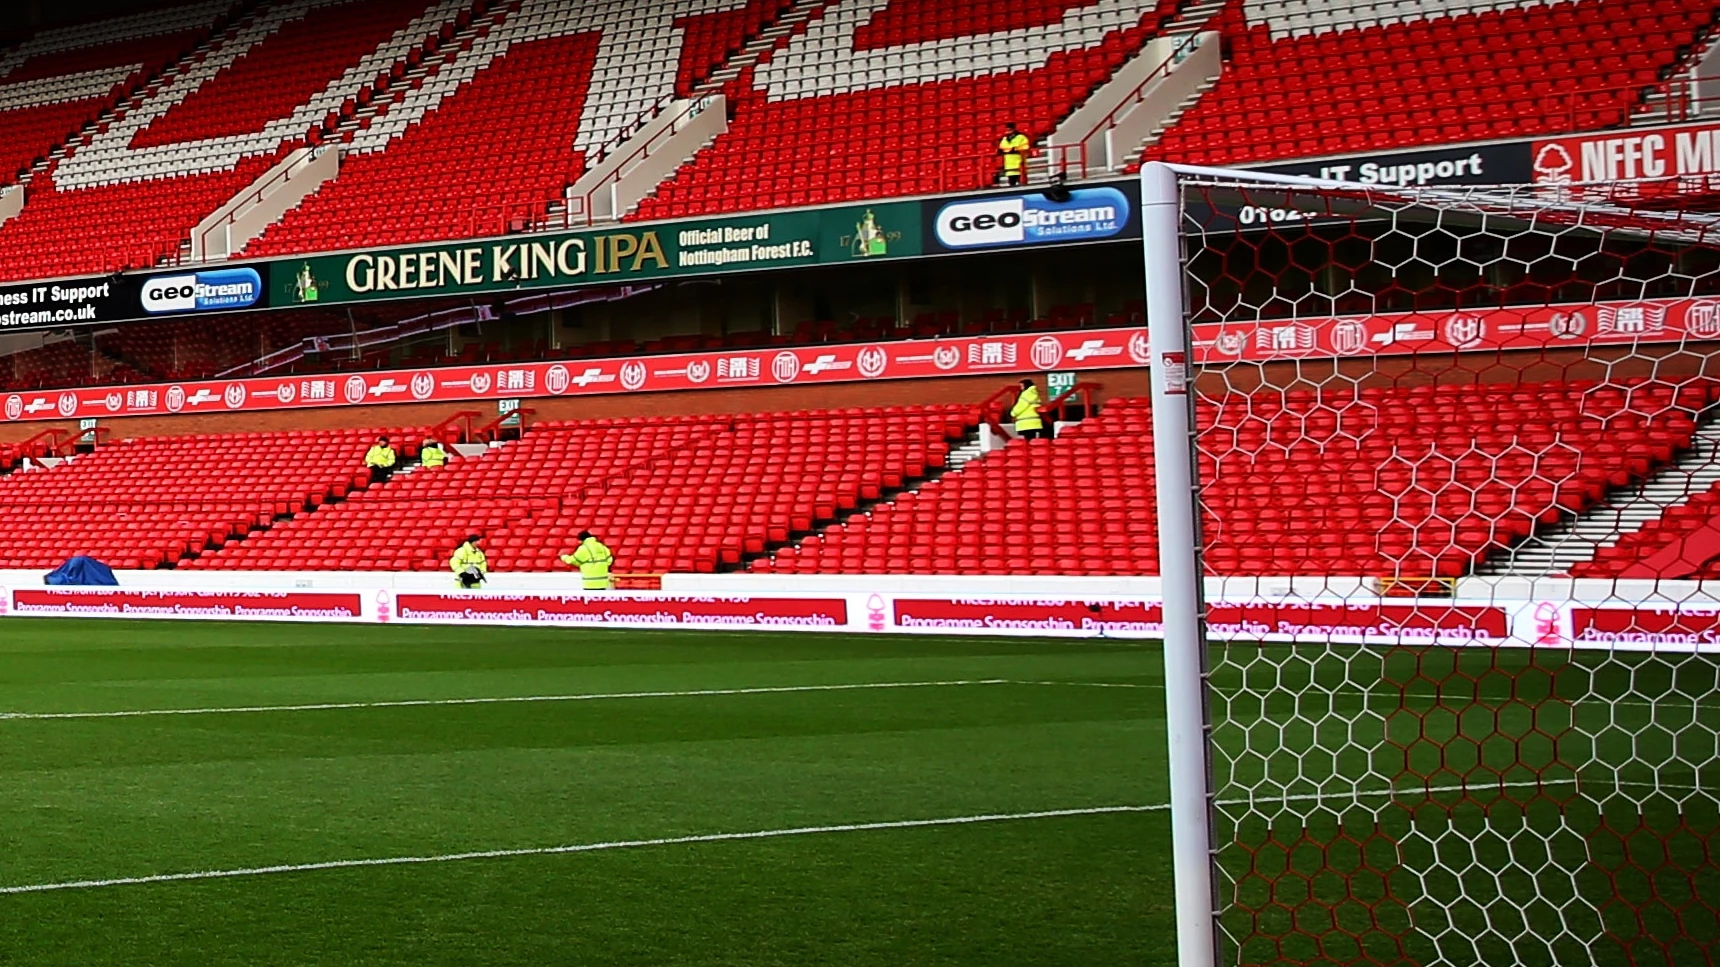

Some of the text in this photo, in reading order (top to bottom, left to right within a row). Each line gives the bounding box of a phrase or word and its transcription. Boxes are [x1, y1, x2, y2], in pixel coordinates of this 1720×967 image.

[1359, 153, 1483, 186] Support
[1581, 134, 1665, 182] NFFC
[679, 223, 769, 246] Official Beer of
[1037, 221, 1118, 236] Solutions Ltd.
[346, 231, 669, 293] GREENE KING IPA
[679, 240, 814, 266] Nottingham Forest F.C.
[32, 287, 46, 303] IT
[50, 282, 109, 304] Support
[1048, 373, 1076, 386] EXIT
[499, 400, 520, 411] EXIT
